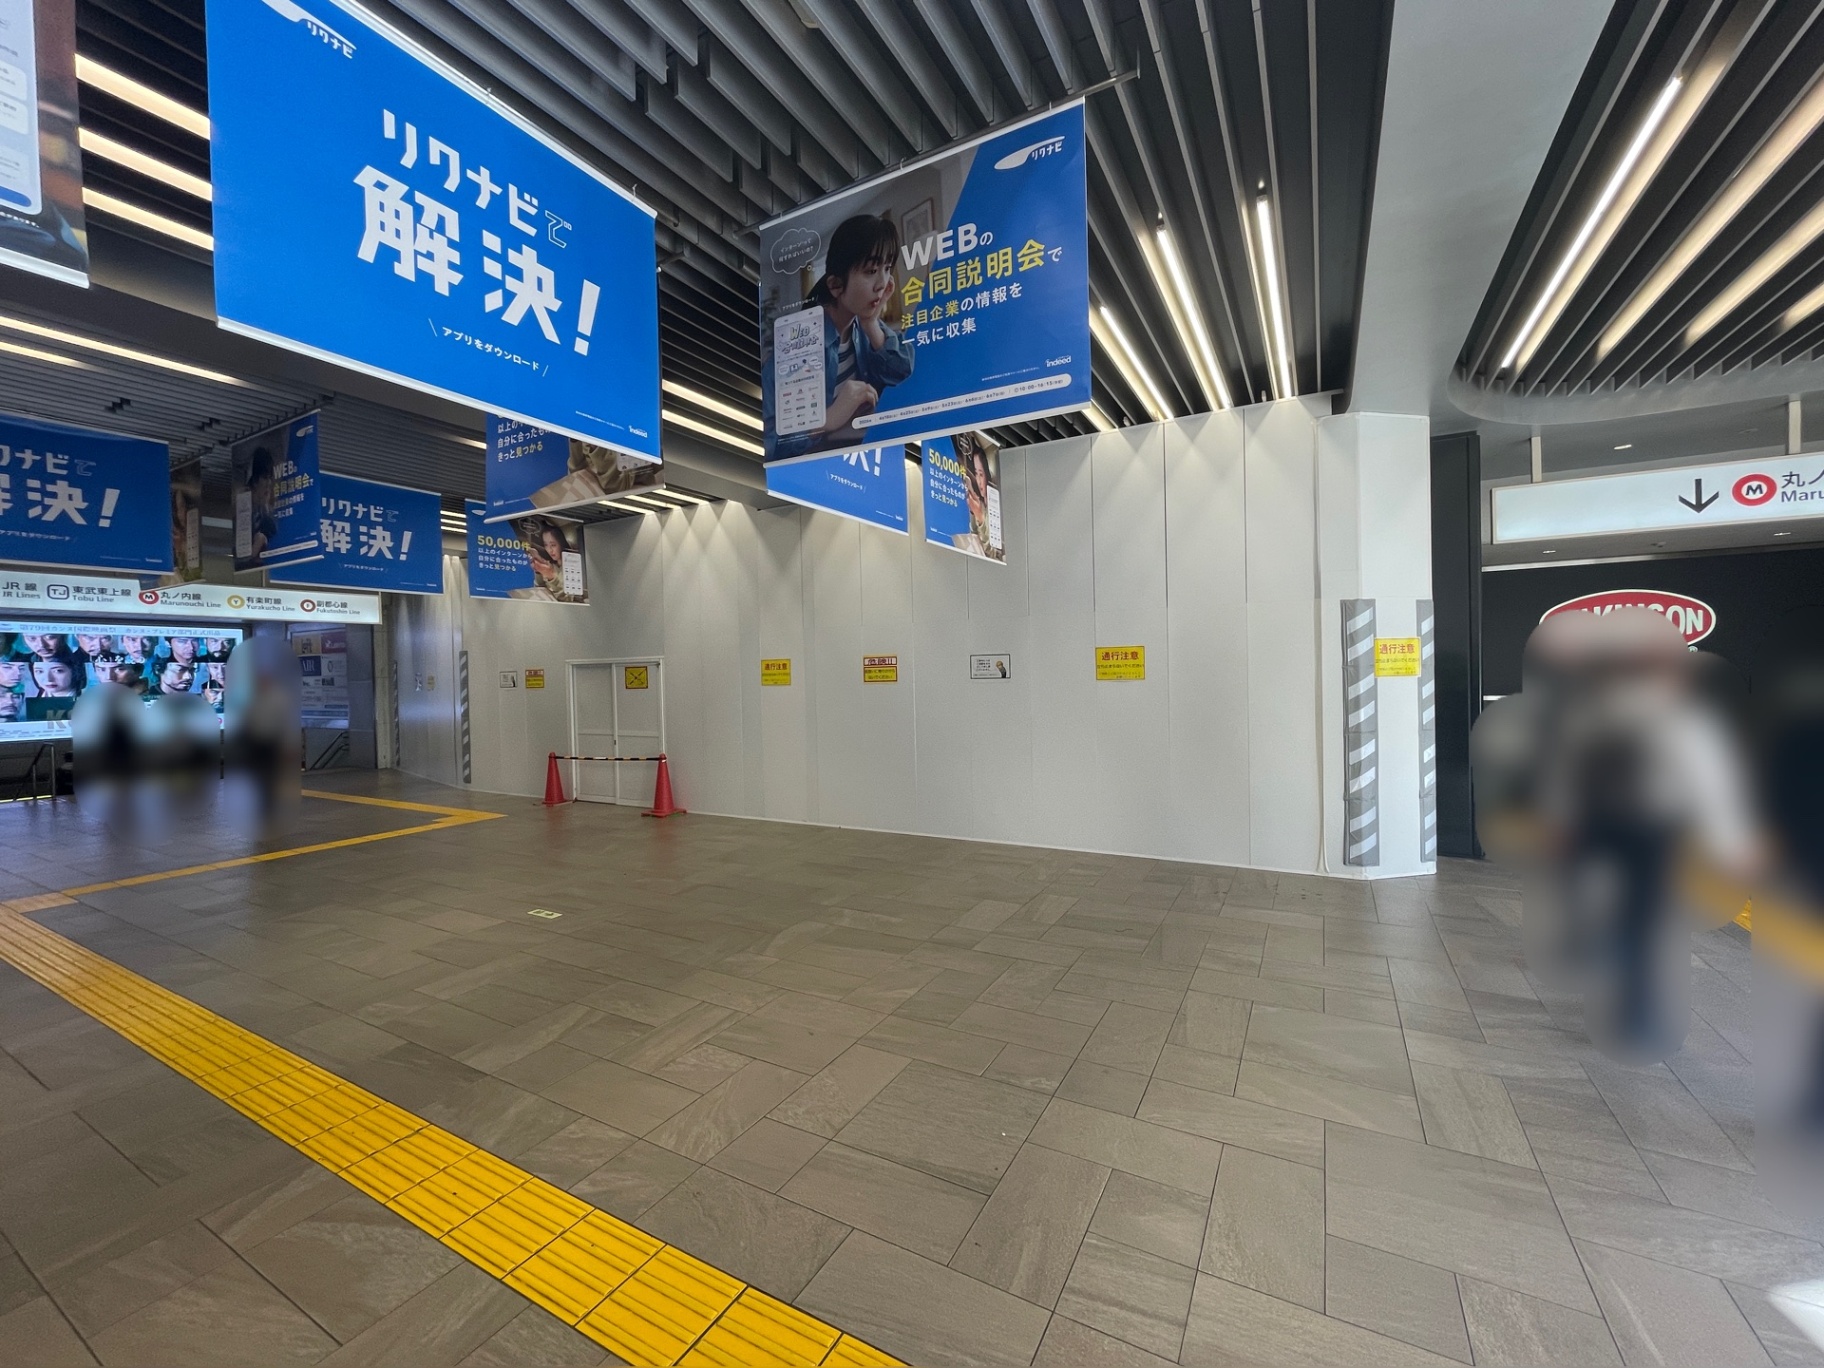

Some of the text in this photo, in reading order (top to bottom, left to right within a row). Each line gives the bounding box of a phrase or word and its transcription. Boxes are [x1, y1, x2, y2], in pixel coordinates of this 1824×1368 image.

[307, 21, 353, 59] リクナビ
[1031, 140, 1063, 160] リクナビ
[383, 108, 572, 248] リクナビで
[901, 222, 994, 271] WEBの
[901, 239, 1063, 306] 合同説明会で
[901, 282, 1023, 329] 注目企業の情報を
[901, 317, 977, 347] 一気に収集
[442, 326, 540, 371] アプリをダウンロード
[498, 441, 543, 462] きっと見つかる
[928, 448, 967, 477] 50,000件
[477, 534, 531, 551] 50,000件
[2, 581, 20, 591] JR
[72, 585, 132, 597] 東武東上線
[16, 591, 41, 599] Lines
[73, 594, 94, 602] Tobu
[160, 591, 202, 601] 丸ノ内線
[160, 599, 205, 608] Marunouchi
[246, 604, 281, 612] Yurakucho
[316, 600, 348, 609] 副都心線
[1380, 643, 1415, 654] 通行注意
[1101, 651, 1140, 661] 通行注意
[764, 663, 787, 671] 通行注意
